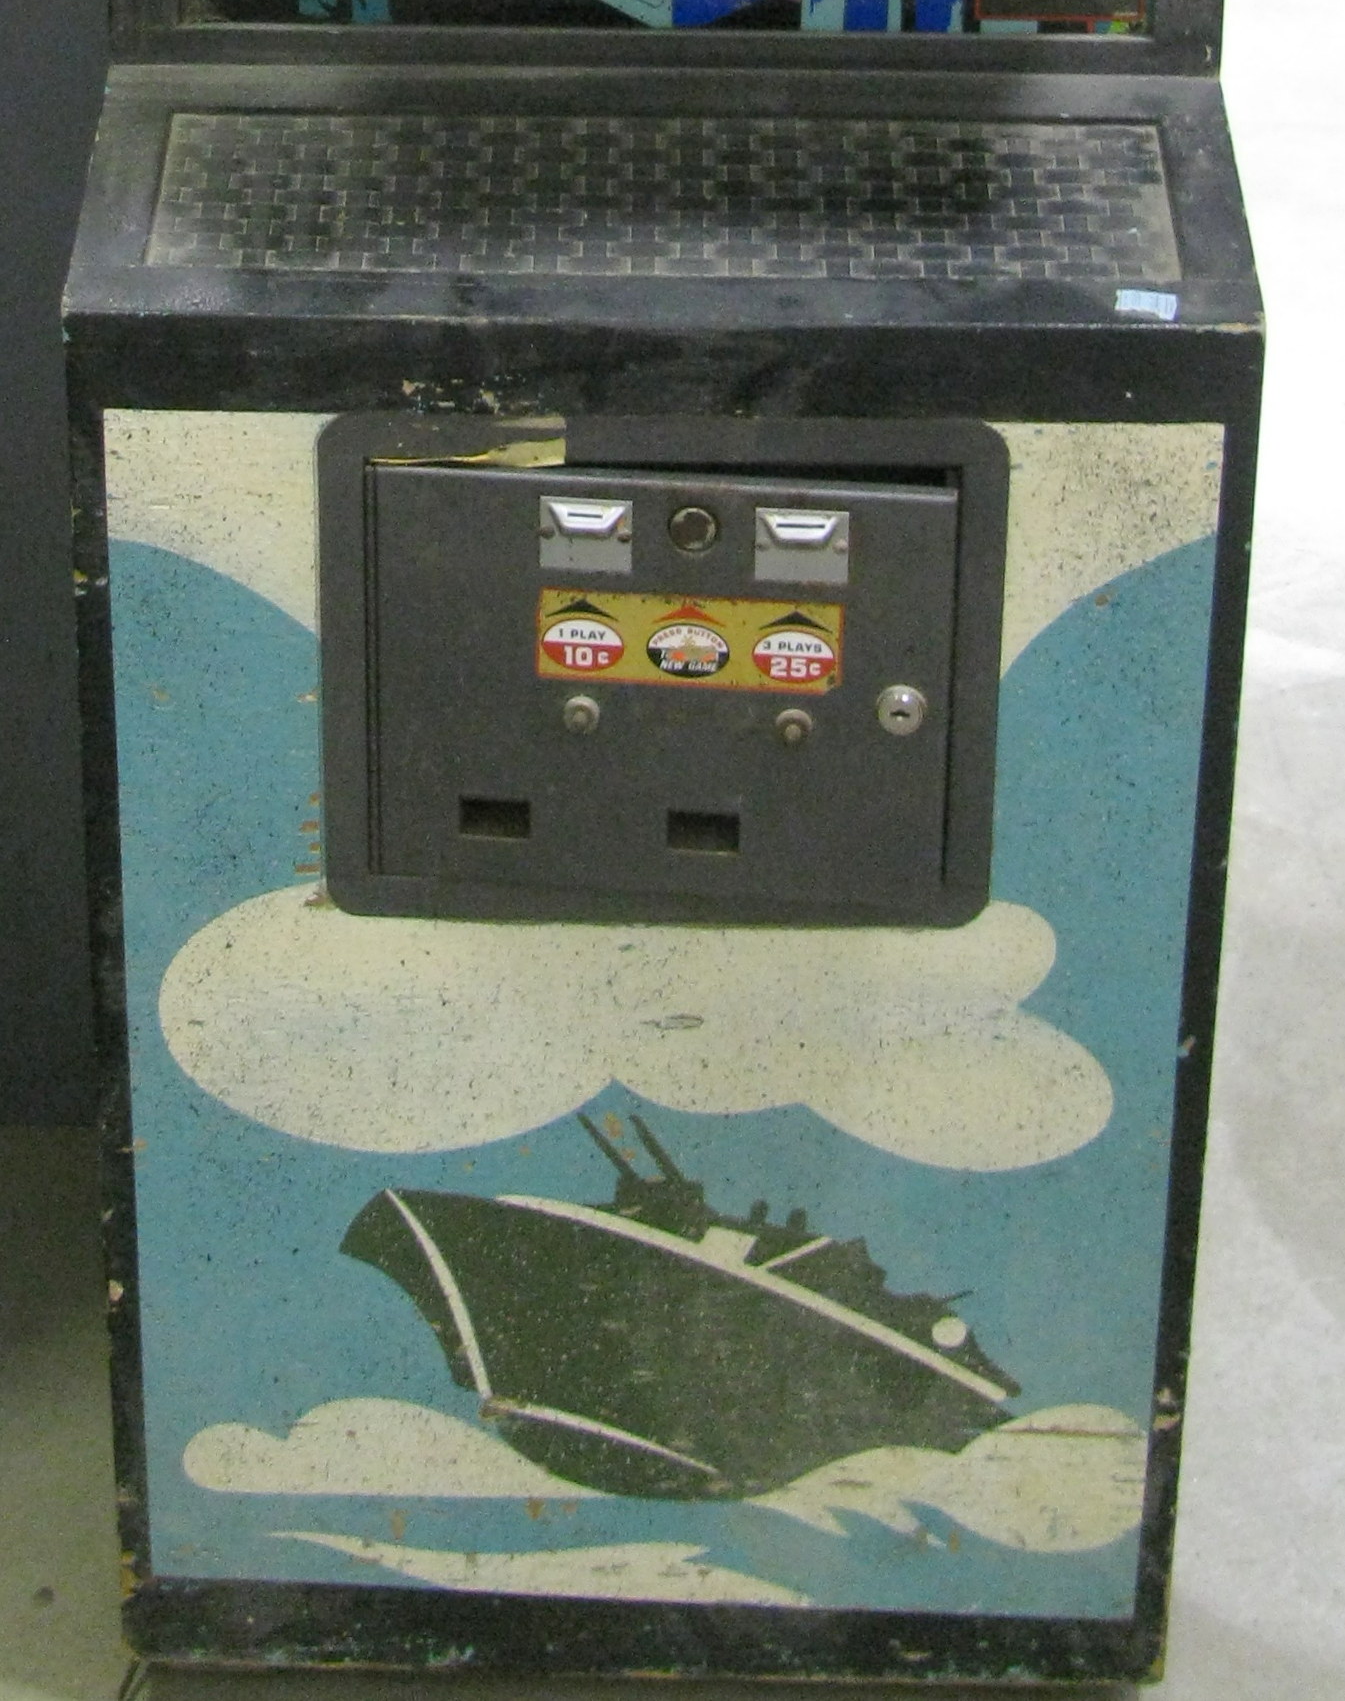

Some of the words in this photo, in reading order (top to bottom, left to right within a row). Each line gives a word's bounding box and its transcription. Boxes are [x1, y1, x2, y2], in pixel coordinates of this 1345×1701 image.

[570, 628, 607, 641] PLAY
[763, 640, 772, 651] 3
[778, 640, 823, 654] PLAYS
[659, 659, 683, 671] NEW
[687, 659, 718, 673] GAME
